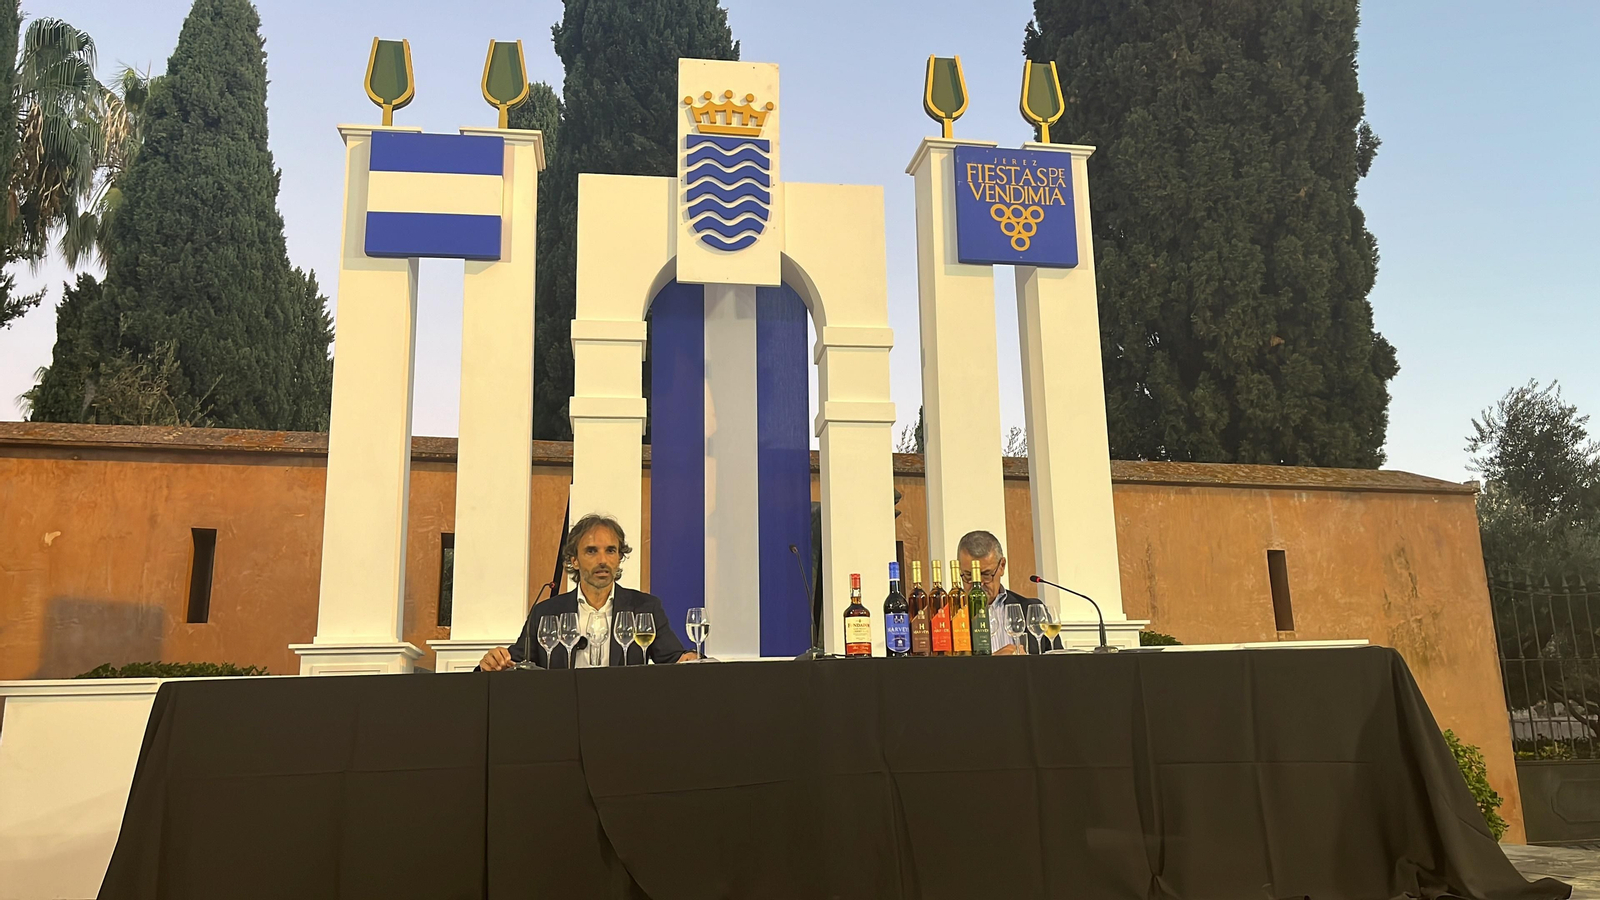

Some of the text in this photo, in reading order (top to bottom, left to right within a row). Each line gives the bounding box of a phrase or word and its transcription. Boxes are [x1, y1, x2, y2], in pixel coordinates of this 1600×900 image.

[993, 157, 1037, 167] JEREZ
[966, 162, 1047, 187] FIESTAS
[1048, 167, 1066, 179] DE
[1049, 177, 1067, 188] LA
[968, 181, 1067, 206] VENDIMIA
